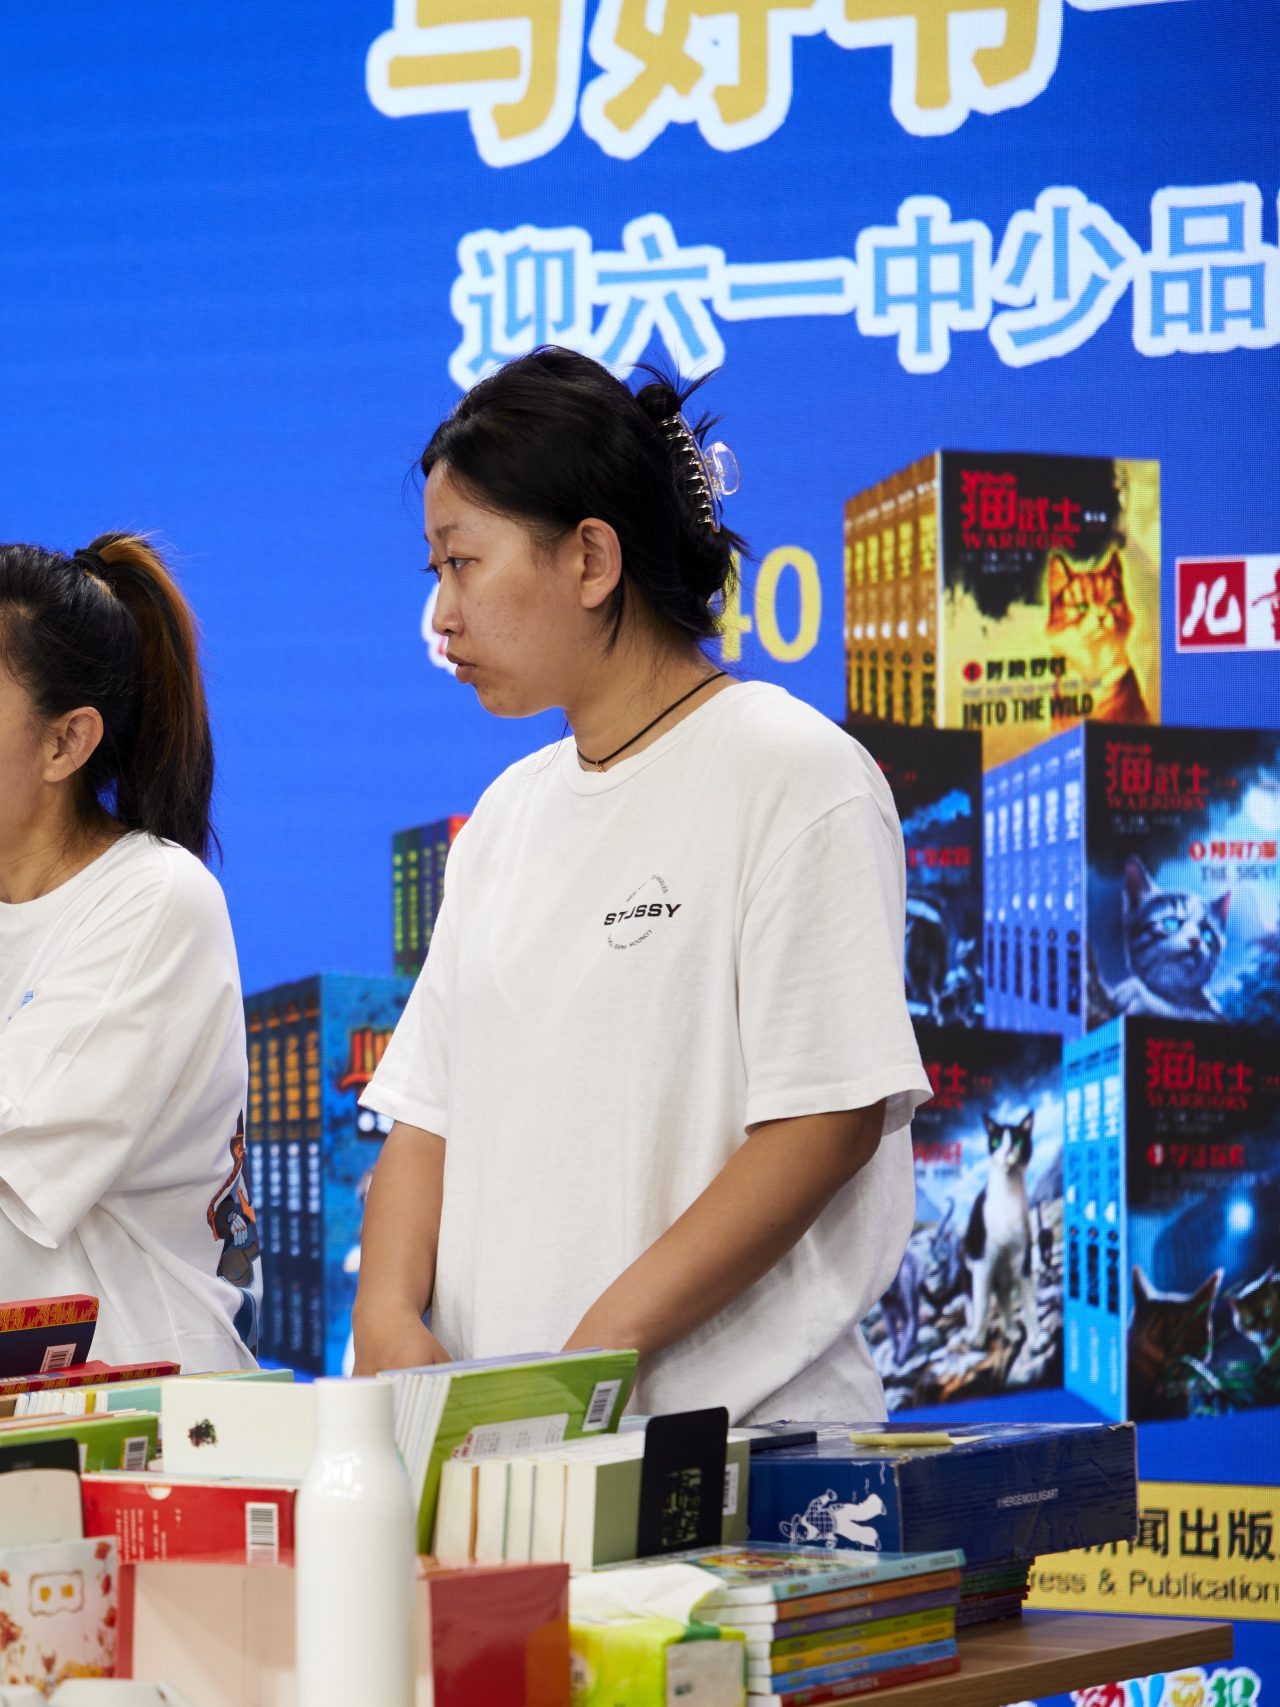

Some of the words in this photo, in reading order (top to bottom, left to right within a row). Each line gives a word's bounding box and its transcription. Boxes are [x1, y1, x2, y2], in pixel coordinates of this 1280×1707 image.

[963, 701, 1007, 728] INTO
[1012, 698, 1045, 722] THE
[1050, 694, 1093, 718] WILD
[1030, 1571, 1087, 1594] ress
[1097, 1567, 1117, 1592] &
